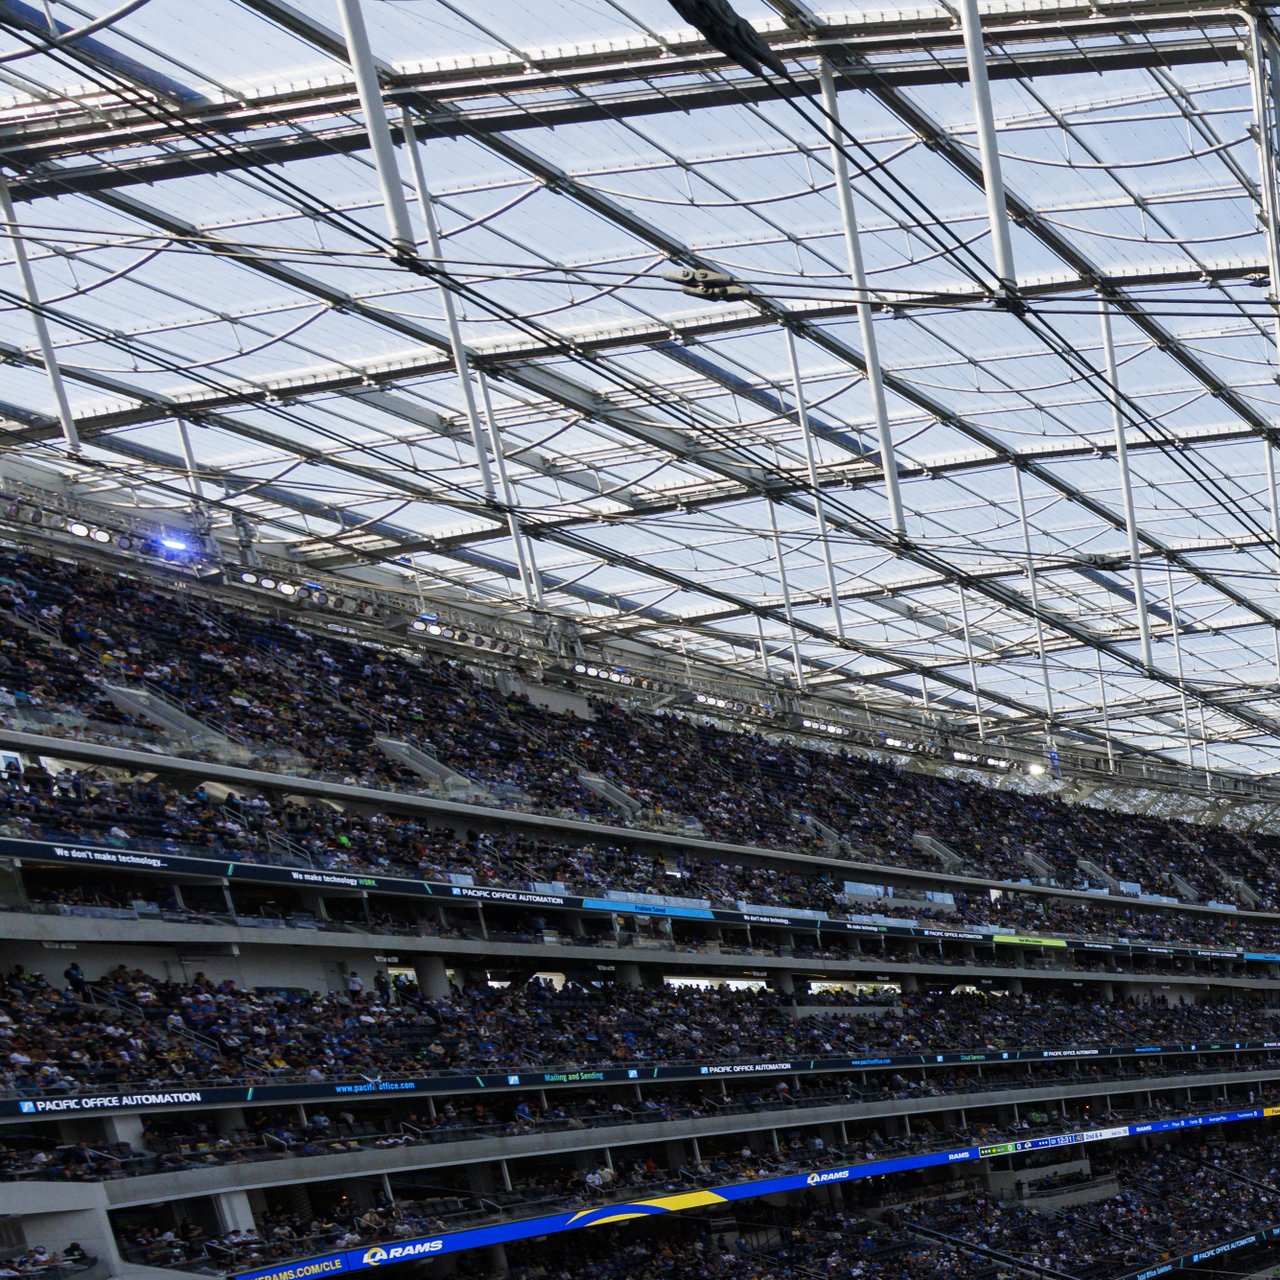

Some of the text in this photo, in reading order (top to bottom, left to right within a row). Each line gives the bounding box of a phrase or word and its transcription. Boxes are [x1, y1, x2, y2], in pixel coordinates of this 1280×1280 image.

[54, 847, 117, 862] We don't make
[462, 889, 564, 905] PACIFIC OFFICE AUTOMATION
[709, 1066, 732, 1074] PACIFIC
[755, 1063, 791, 1071] AUTOMATION
[37, 1092, 201, 1112] PACIFIC OFFICE AUTOMATION
[821, 1171, 849, 1181] RAMS
[389, 1240, 442, 1258] RAMS
